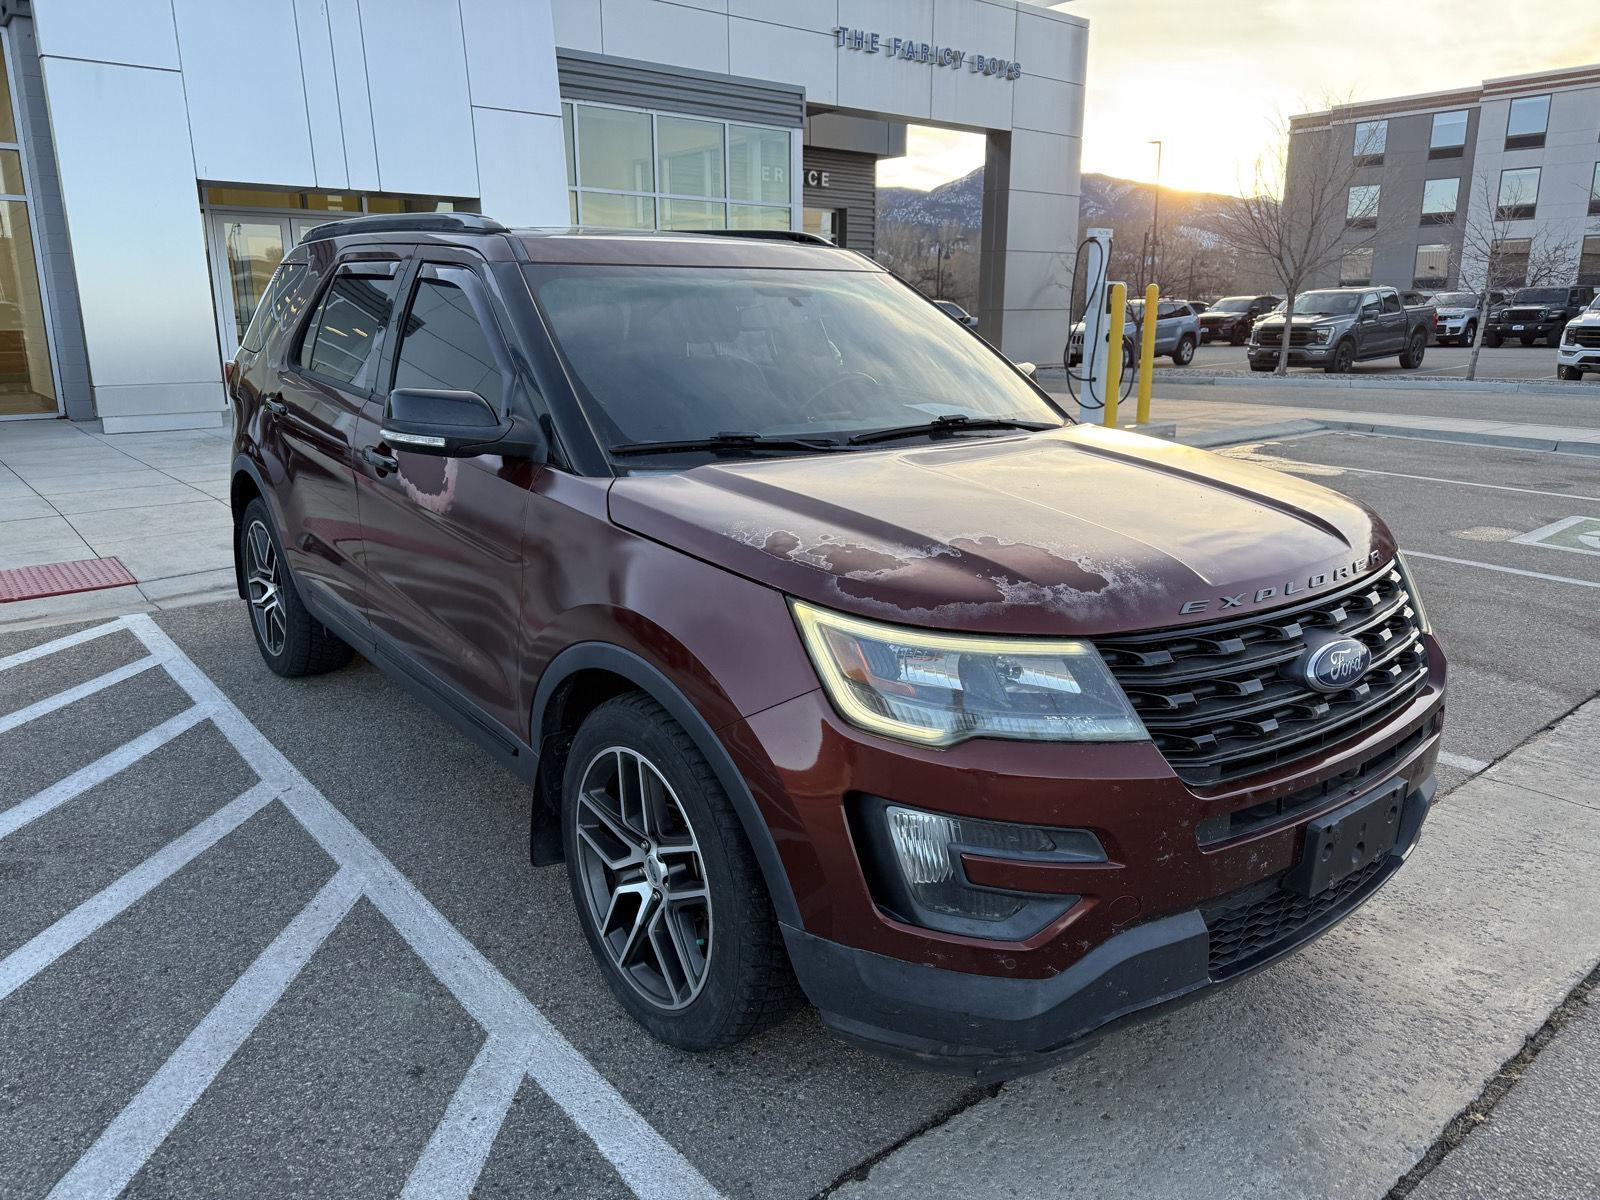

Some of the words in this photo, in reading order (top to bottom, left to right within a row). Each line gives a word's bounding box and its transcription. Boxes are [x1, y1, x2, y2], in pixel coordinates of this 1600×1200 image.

[834, 26, 880, 53] THE
[887, 37, 966, 69] FARICY
[972, 54, 1022, 80] BOYS
[1178, 549, 1383, 616] EXPLORER
[1330, 647, 1364, 681] Ford
